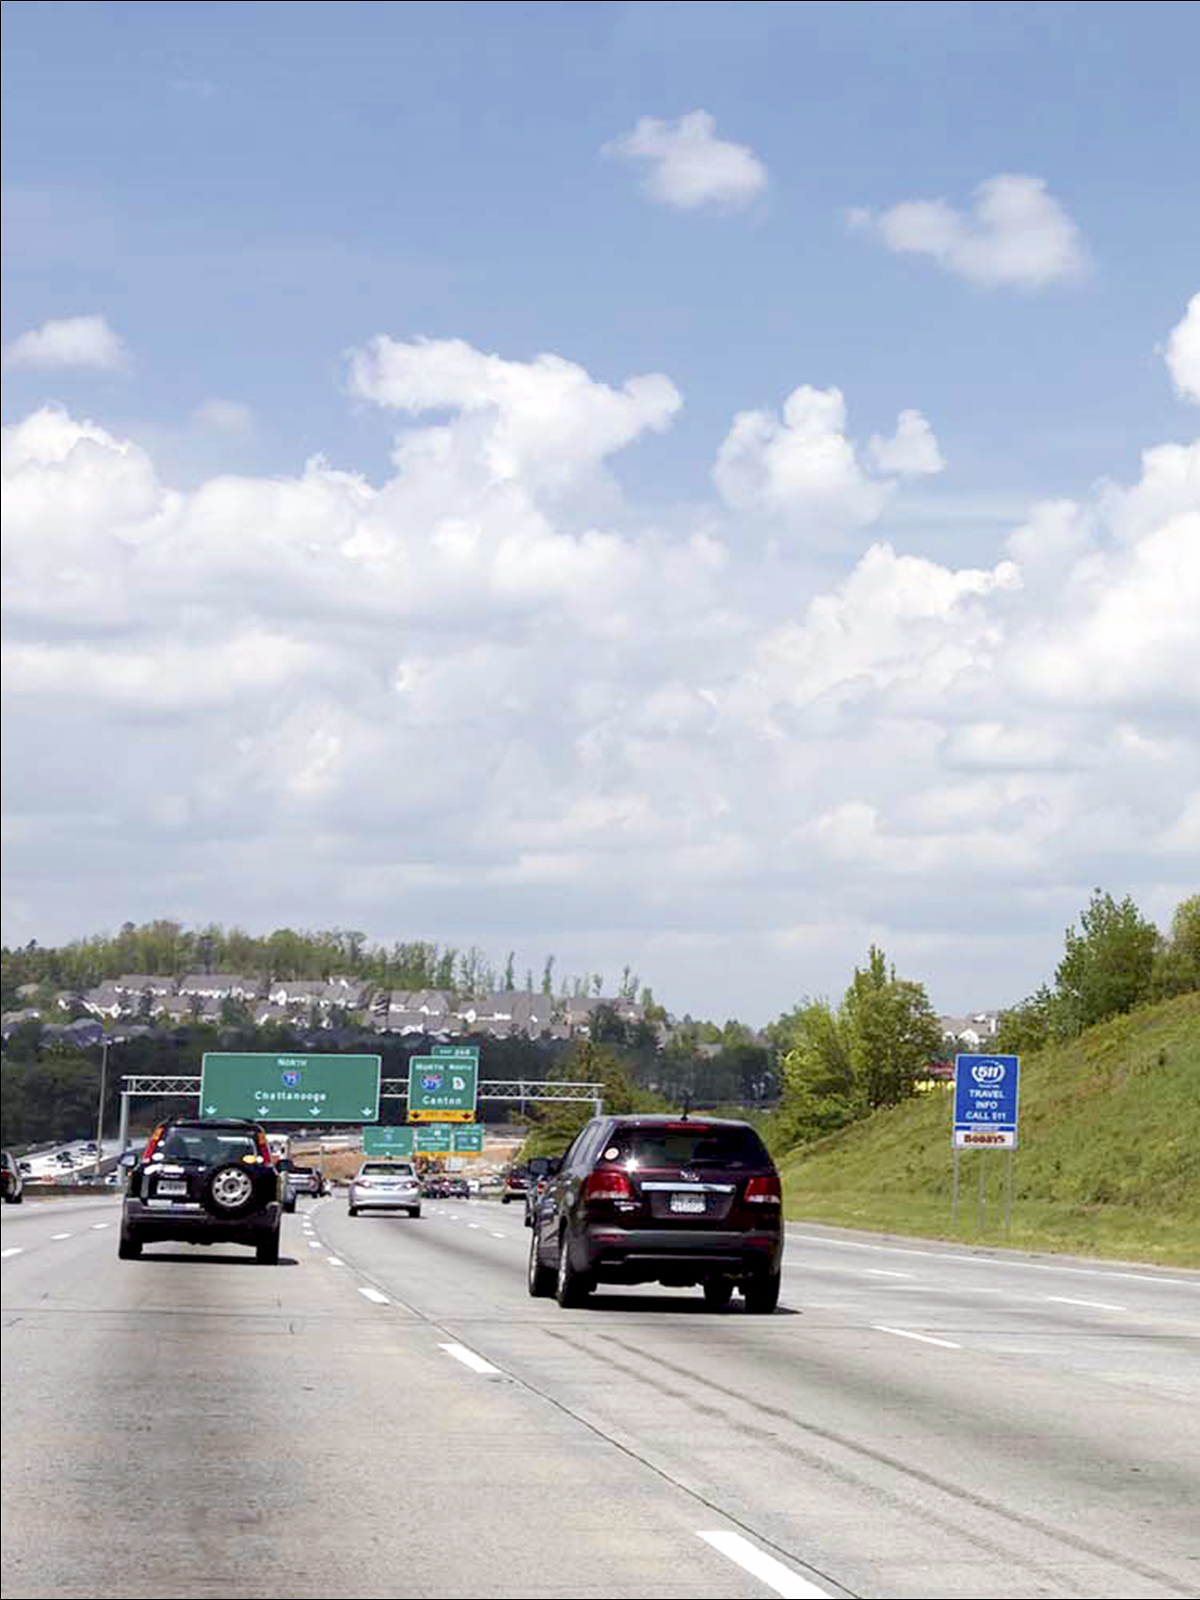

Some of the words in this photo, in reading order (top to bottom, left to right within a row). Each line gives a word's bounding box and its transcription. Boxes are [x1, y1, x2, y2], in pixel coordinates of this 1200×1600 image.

[277, 1058, 307, 1068] NORTH
[977, 1065, 999, 1078] 511
[254, 1091, 327, 1103] Chattanooga
[968, 1089, 1004, 1099] TRAVEL
[421, 1095, 462, 1106] Canton
[974, 1101, 998, 1110] INFO
[965, 1111, 989, 1120] CALL
